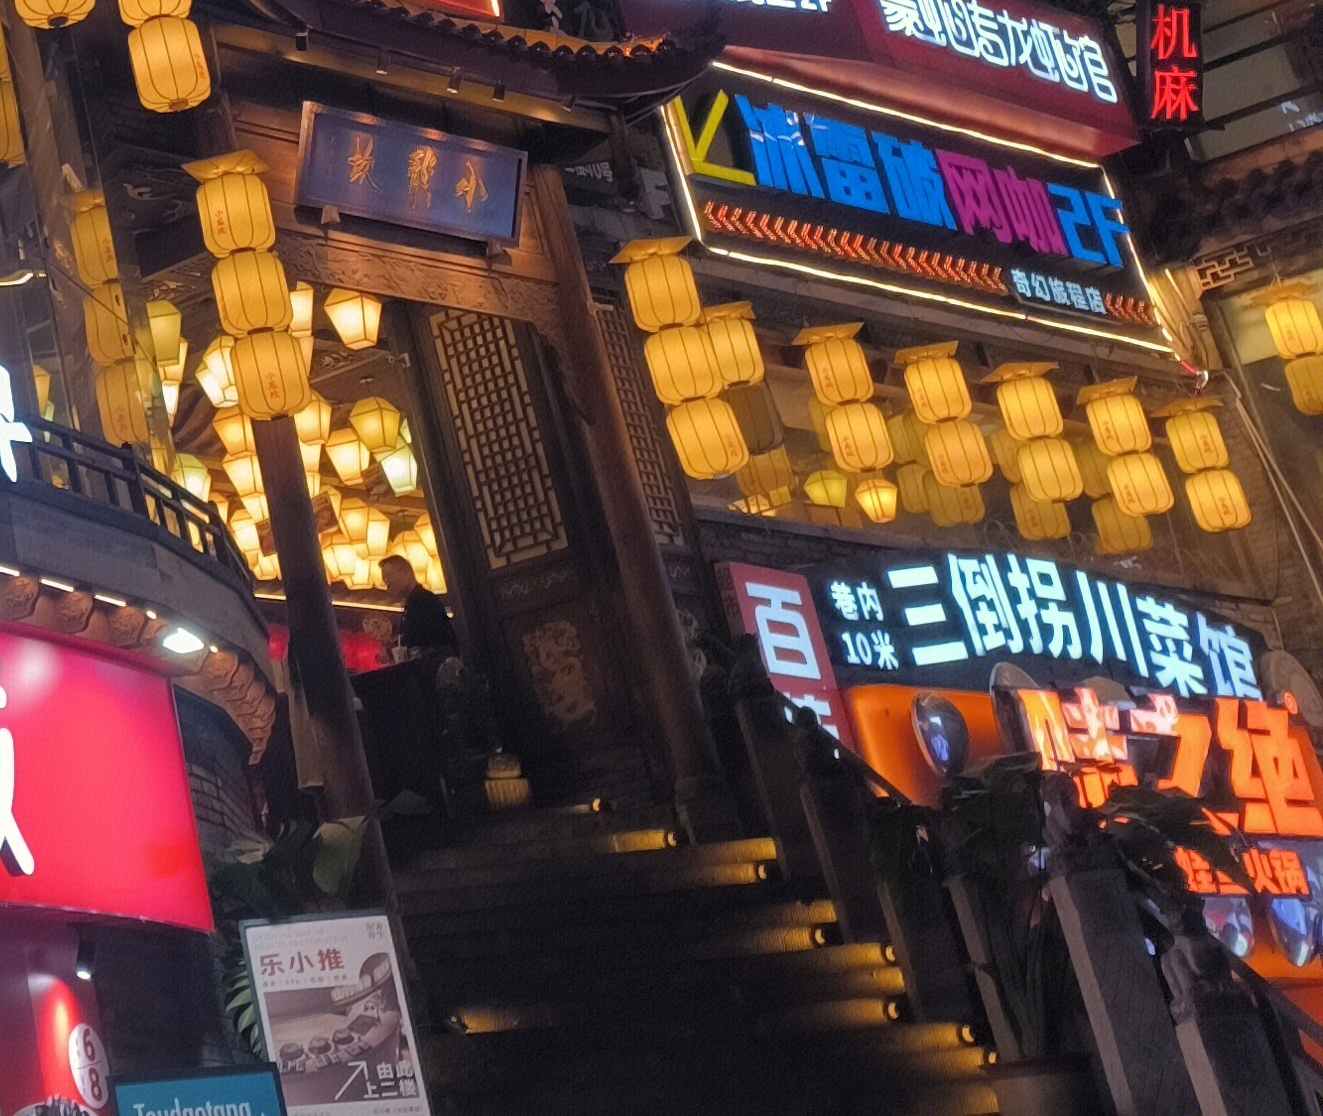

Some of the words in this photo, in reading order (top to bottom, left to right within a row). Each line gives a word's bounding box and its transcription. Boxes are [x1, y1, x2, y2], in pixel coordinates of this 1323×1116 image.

[1151, 3, 1201, 123] 机麻
[829, 580, 885, 622] 巷内
[887, 551, 1264, 703] 三倒拐川菜馆
[841, 629, 900, 671] 10米
